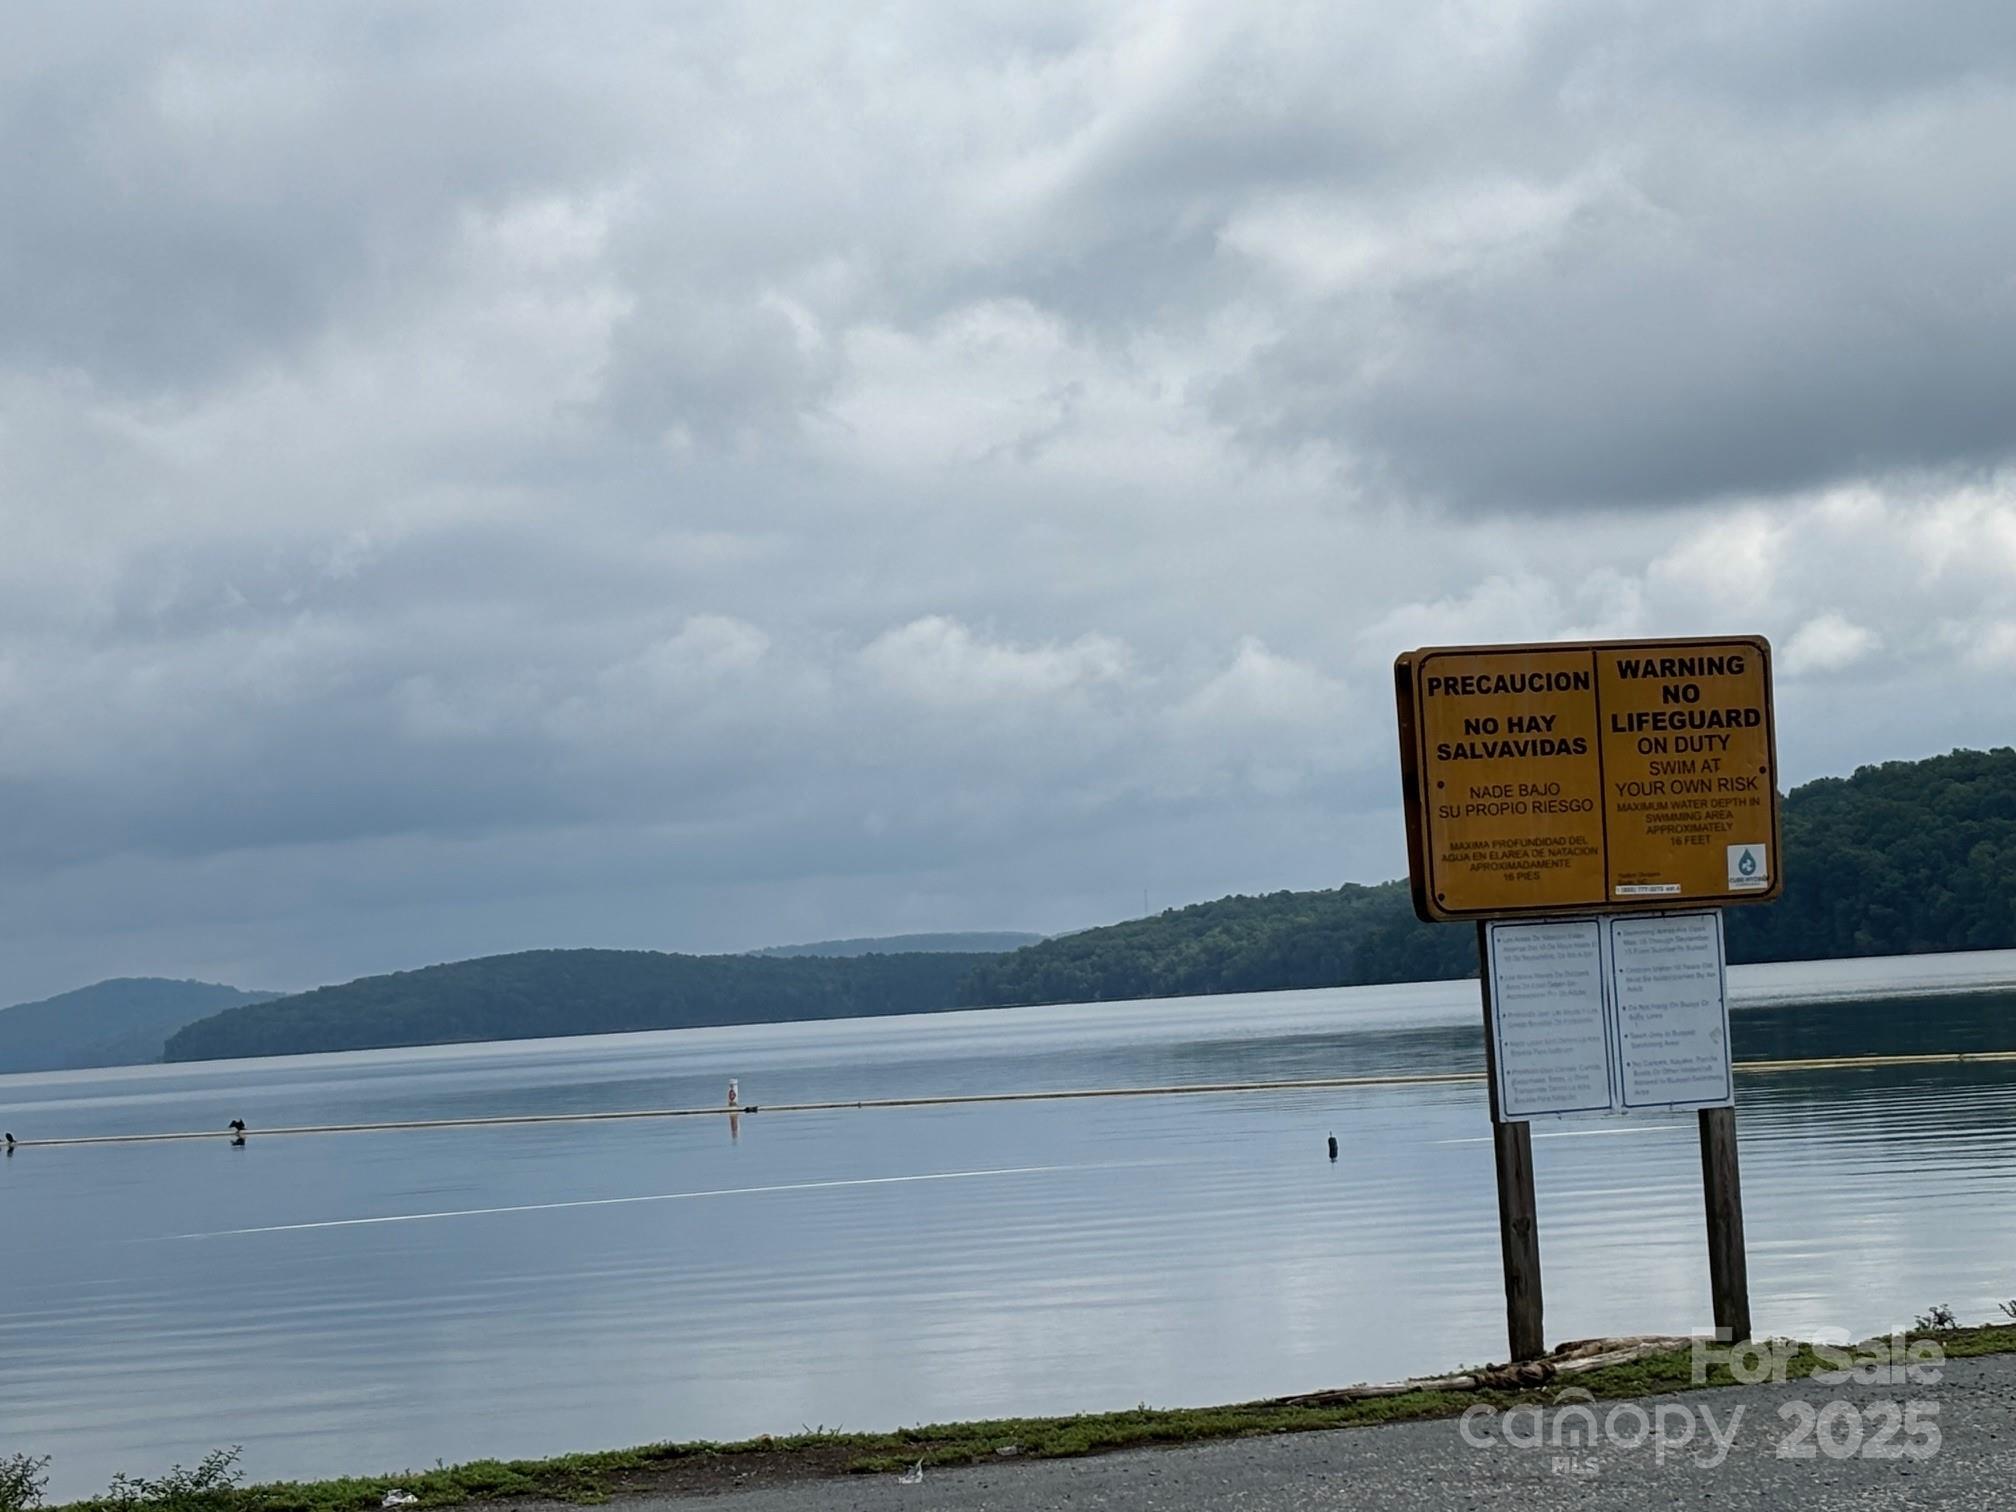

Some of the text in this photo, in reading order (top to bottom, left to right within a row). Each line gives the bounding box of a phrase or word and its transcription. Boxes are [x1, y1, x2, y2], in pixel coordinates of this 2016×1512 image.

[1616, 655, 1744, 679] WARNING
[1427, 671, 1590, 696] PRECAUCION
[1662, 684, 1700, 704] NO
[1464, 715, 1557, 735] NO HAY
[1611, 708, 1761, 732] LIFEGUARD
[1436, 737, 1587, 760] SALVAVIDAS
[1637, 734, 1730, 754] ON DUTY
[1649, 758, 1722, 776] SWIM AT
[1470, 782, 1561, 799] NADE BAJO
[1615, 776, 1758, 797] YOUR OWN RISK
[1439, 798, 1594, 819] SU PROPIO RIESGO
[1617, 797, 1760, 812] MAXIMUM WATER DEPTH IN
[1646, 810, 1734, 823] SWIMMING AREA
[1646, 822, 1734, 835] APPROXIMATELY
[1450, 835, 1588, 851] MAXIMA PROFUNDIDAD DEL
[1671, 834, 1711, 846] 16 FEET
[1442, 853, 1471, 862] AGUA
[1473, 852, 1487, 861] EN
[1531, 848, 1545, 859] DE
[1549, 847, 1598, 858] NATACION
[1470, 858, 1571, 872] APROXIMADAMENTE
[1504, 871, 1541, 882] 16 PIES
